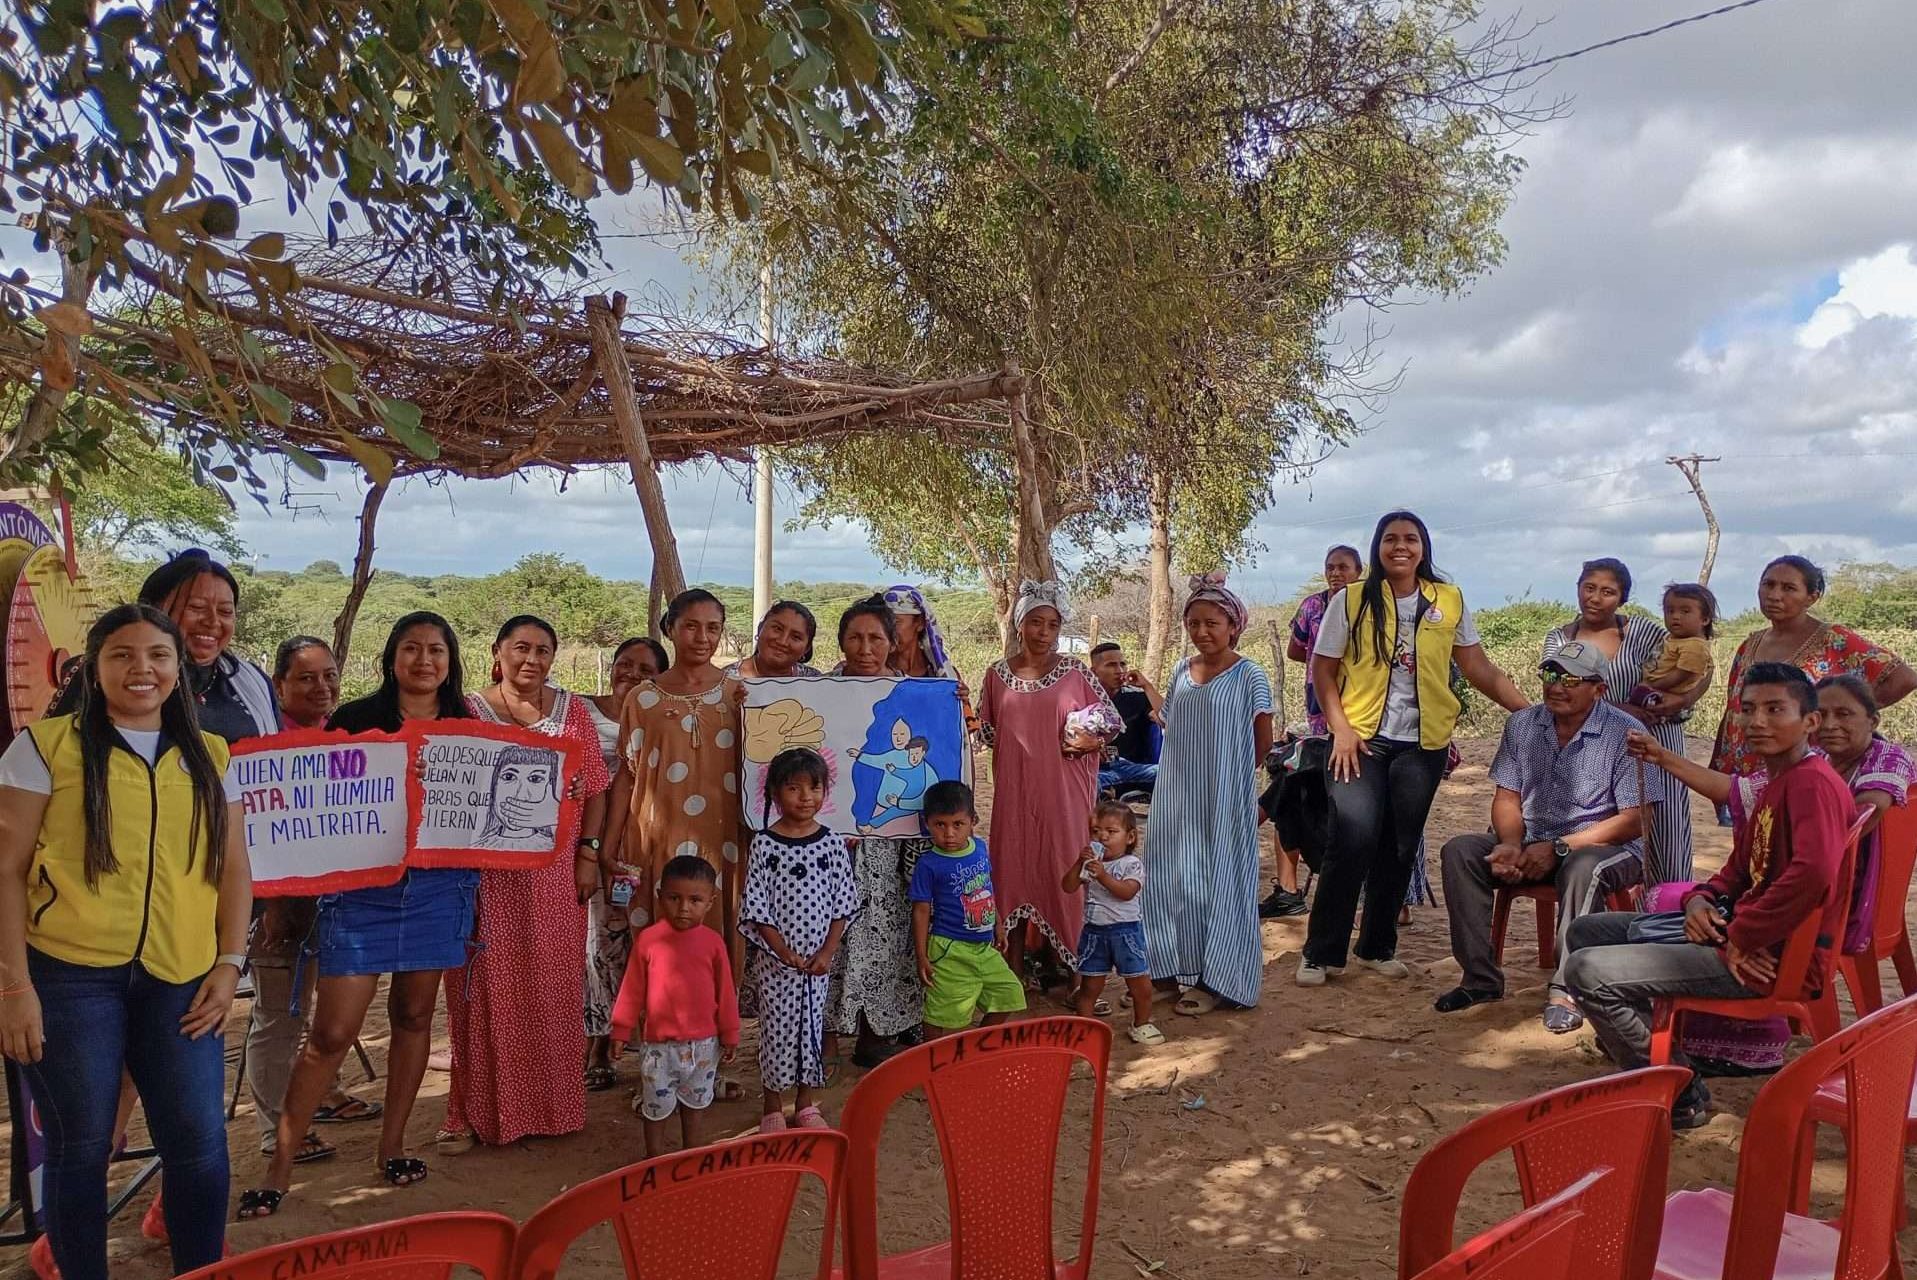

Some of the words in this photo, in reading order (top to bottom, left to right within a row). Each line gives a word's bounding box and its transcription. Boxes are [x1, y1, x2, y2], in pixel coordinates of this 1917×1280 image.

[236, 756, 284, 786] UIEN
[292, 753, 326, 780] AMA
[328, 748, 367, 780] NO
[462, 770, 477, 786] NI
[241, 787, 290, 815] ATA,
[294, 784, 314, 810] NI
[325, 776, 394, 807] HUMILLA
[424, 789, 462, 807] BRAS
[467, 791, 493, 808] QUE
[271, 809, 387, 845] MALTRATA.
[929, 1036, 964, 1073] LA
[620, 1165, 657, 1202] LA
[671, 1135, 818, 1183] CAMPANA
[271, 1230, 409, 1280] CAMPANA
